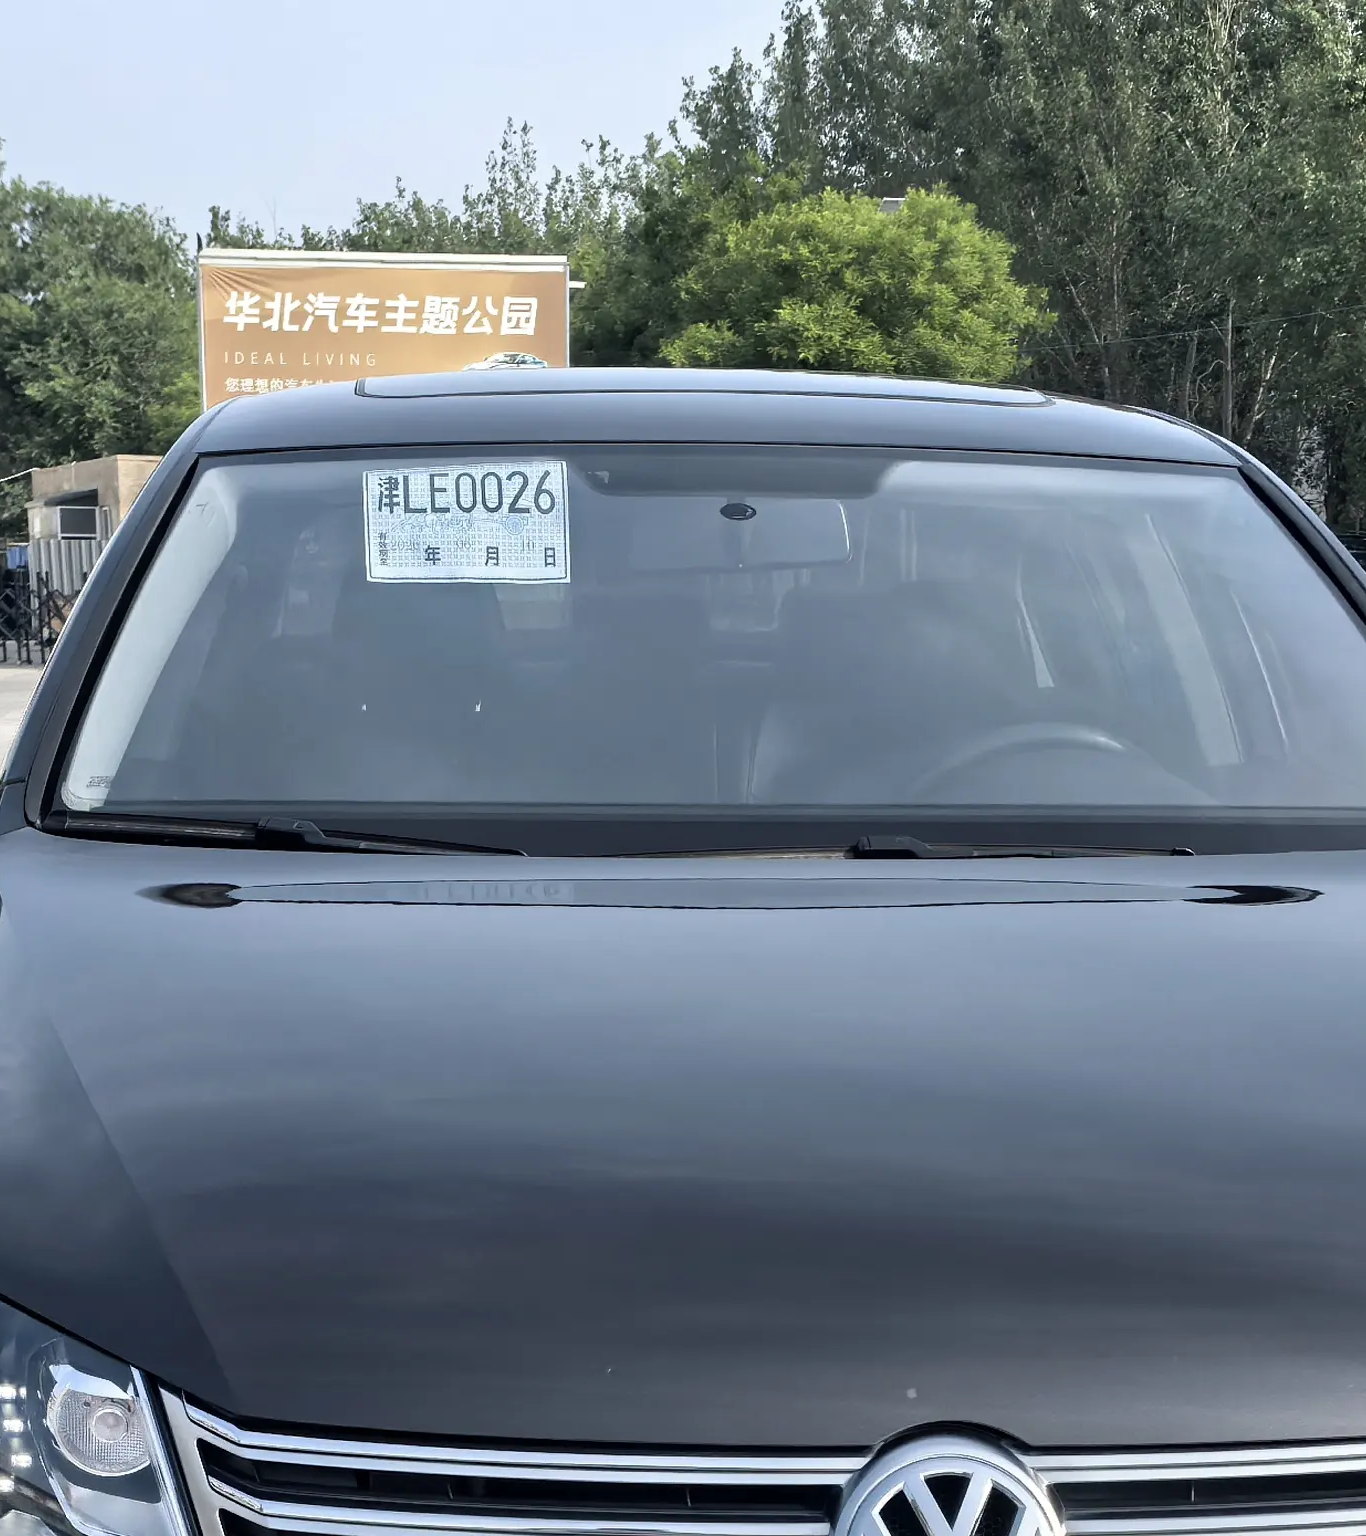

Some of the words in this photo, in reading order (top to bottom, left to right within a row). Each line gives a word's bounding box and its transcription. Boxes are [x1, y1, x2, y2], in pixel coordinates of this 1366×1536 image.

[223, 290, 538, 336] 华北汽车主题公园
[224, 351, 287, 365] IDEAL
[303, 352, 376, 366] LIVING
[378, 470, 556, 514] 津LE0026
[424, 545, 441, 565] 年
[484, 545, 499, 566] 月
[544, 547, 556, 567] 日
